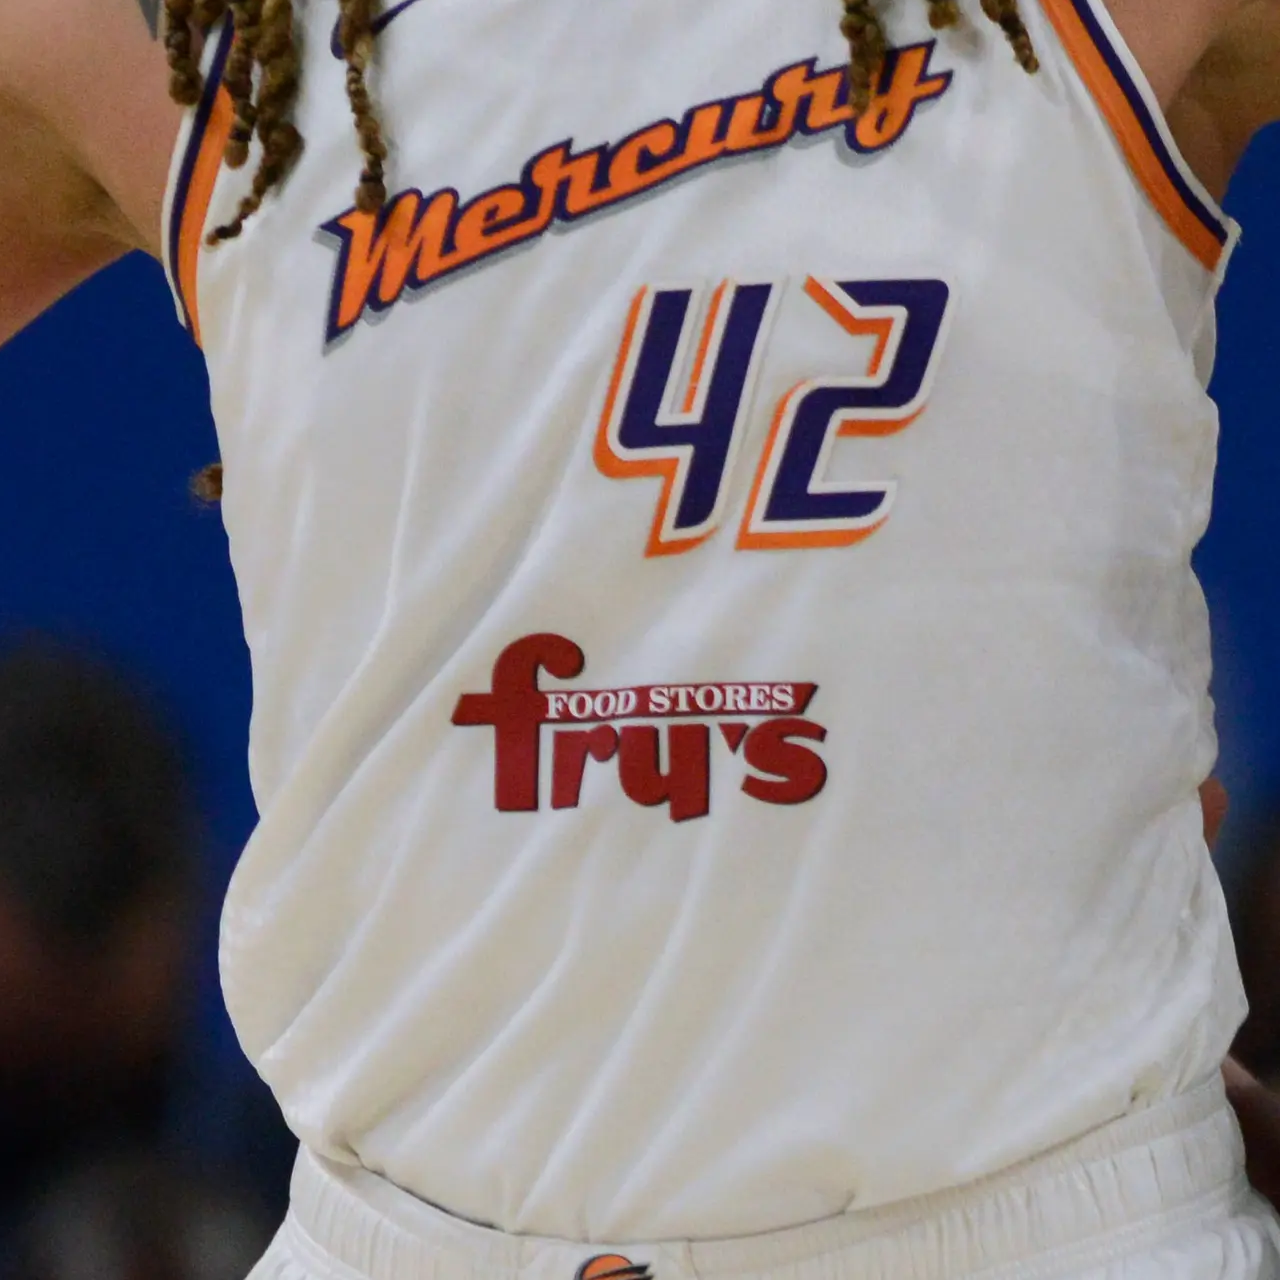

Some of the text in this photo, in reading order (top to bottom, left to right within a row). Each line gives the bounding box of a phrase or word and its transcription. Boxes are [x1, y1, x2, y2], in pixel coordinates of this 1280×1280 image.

[318, 39, 954, 350] Mercury
[593, 273, 953, 557] 42
[451, 633, 828, 823] fry's
[546, 684, 797, 720] FOOD STORES
